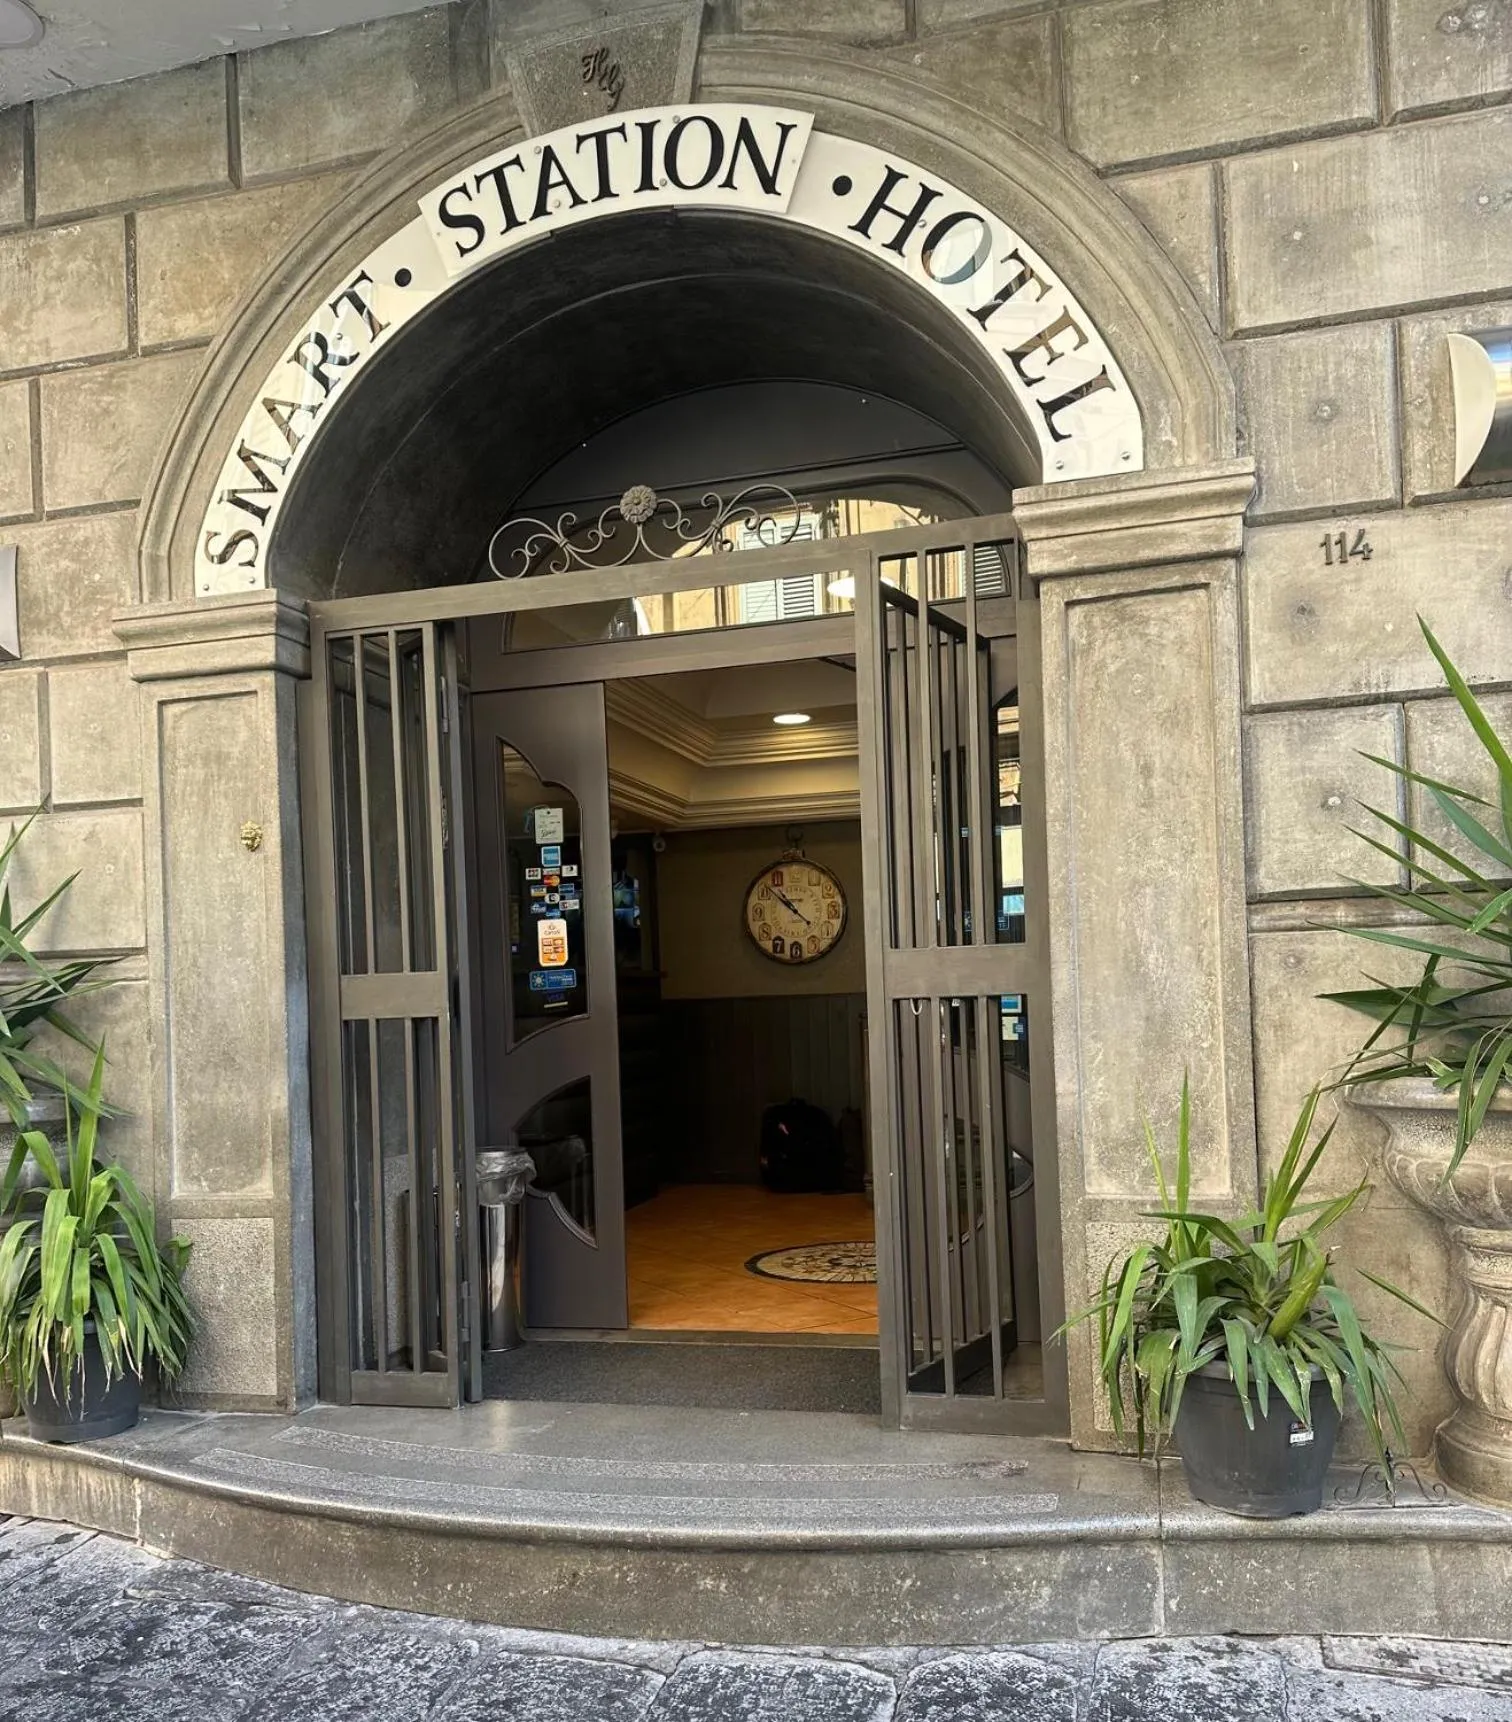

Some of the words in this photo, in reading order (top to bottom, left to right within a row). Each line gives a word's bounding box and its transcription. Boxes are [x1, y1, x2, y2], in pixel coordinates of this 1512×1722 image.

[205, 269, 391, 570] SMART
[437, 115, 798, 258] STATION
[848, 164, 1116, 443] HOTEL
[1319, 528, 1373, 565] 114
